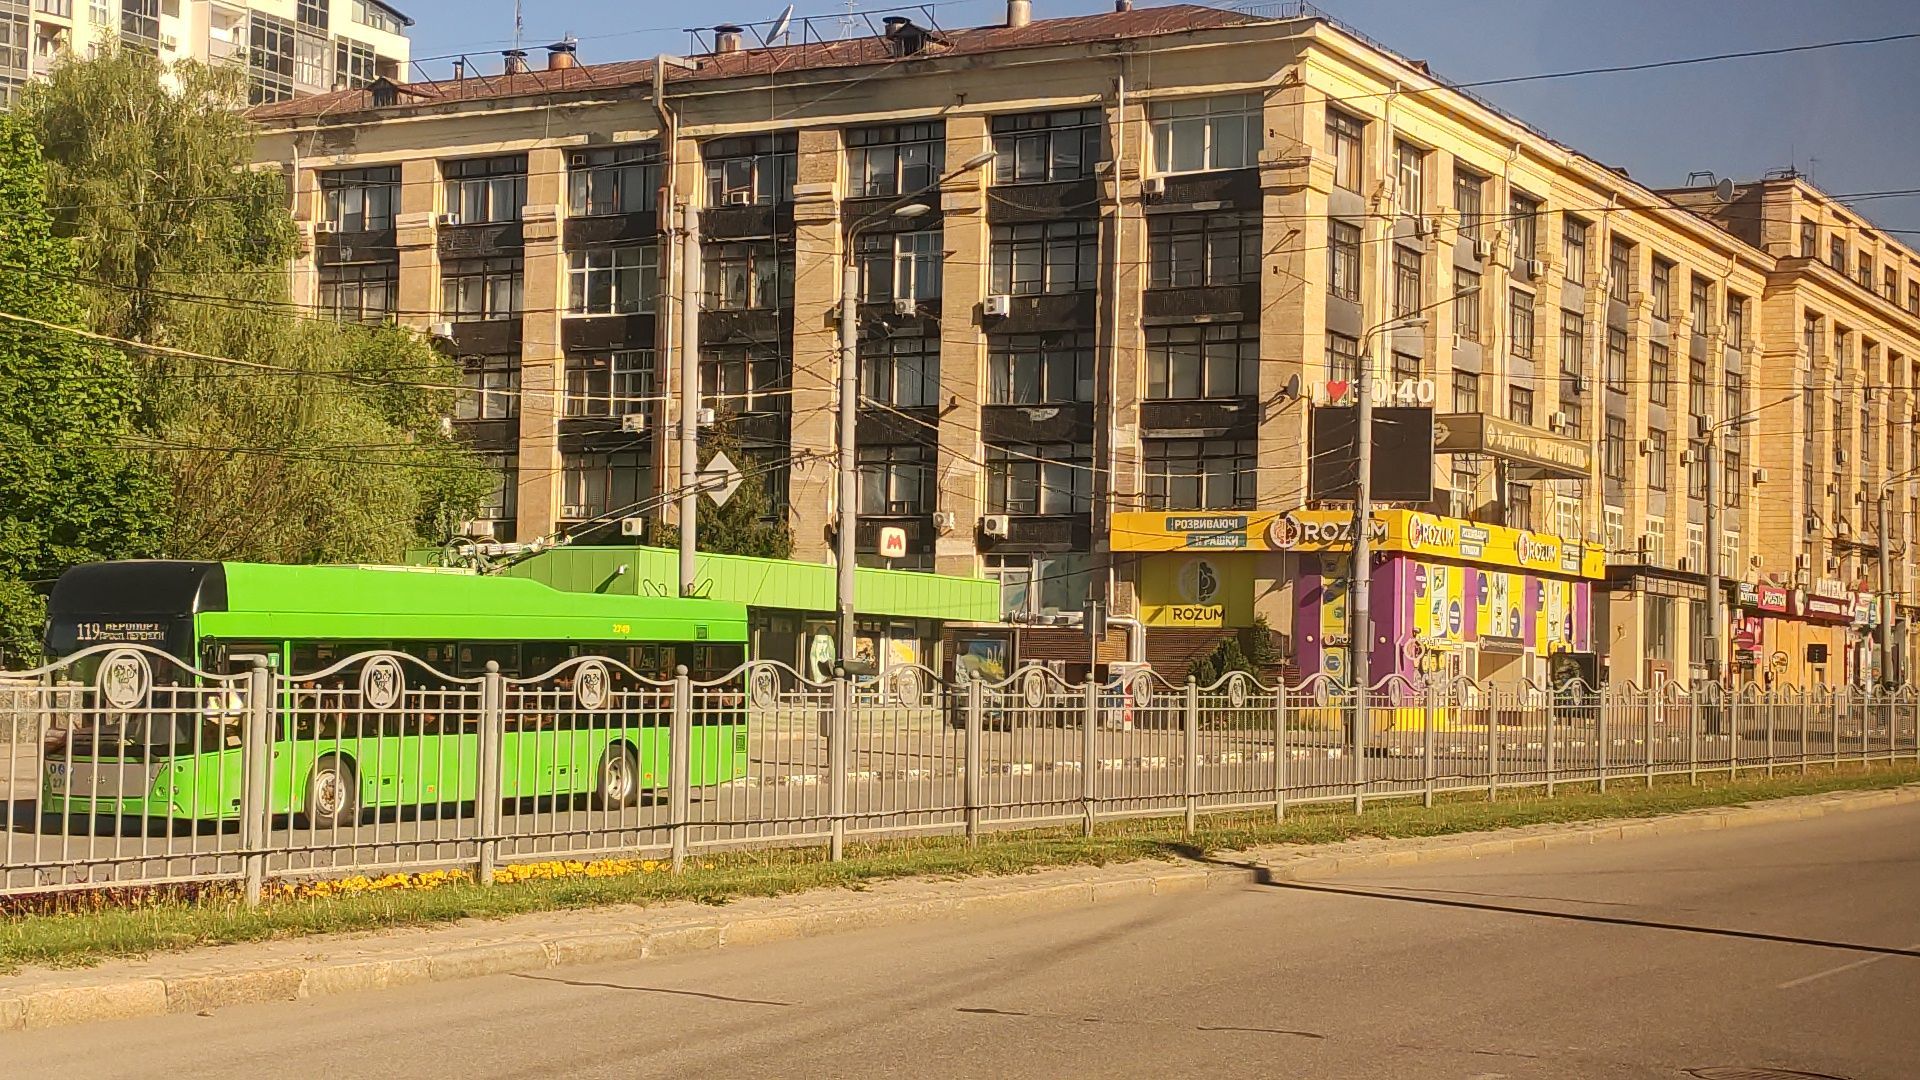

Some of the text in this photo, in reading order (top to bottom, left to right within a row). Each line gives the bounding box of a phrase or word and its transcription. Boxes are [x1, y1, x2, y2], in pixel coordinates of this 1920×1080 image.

[1173, 518, 1239, 530] РОЗВИВАЮЧІ
[1304, 521, 1389, 541] ROZM
[887, 534, 902, 550] М
[1195, 534, 1239, 546] ІГРАШКИ
[1421, 525, 1455, 547] ROZUM
[1528, 541, 1556, 563] ROZUM
[1173, 608, 1226, 621] ROZUM
[77, 623, 100, 640] 119
